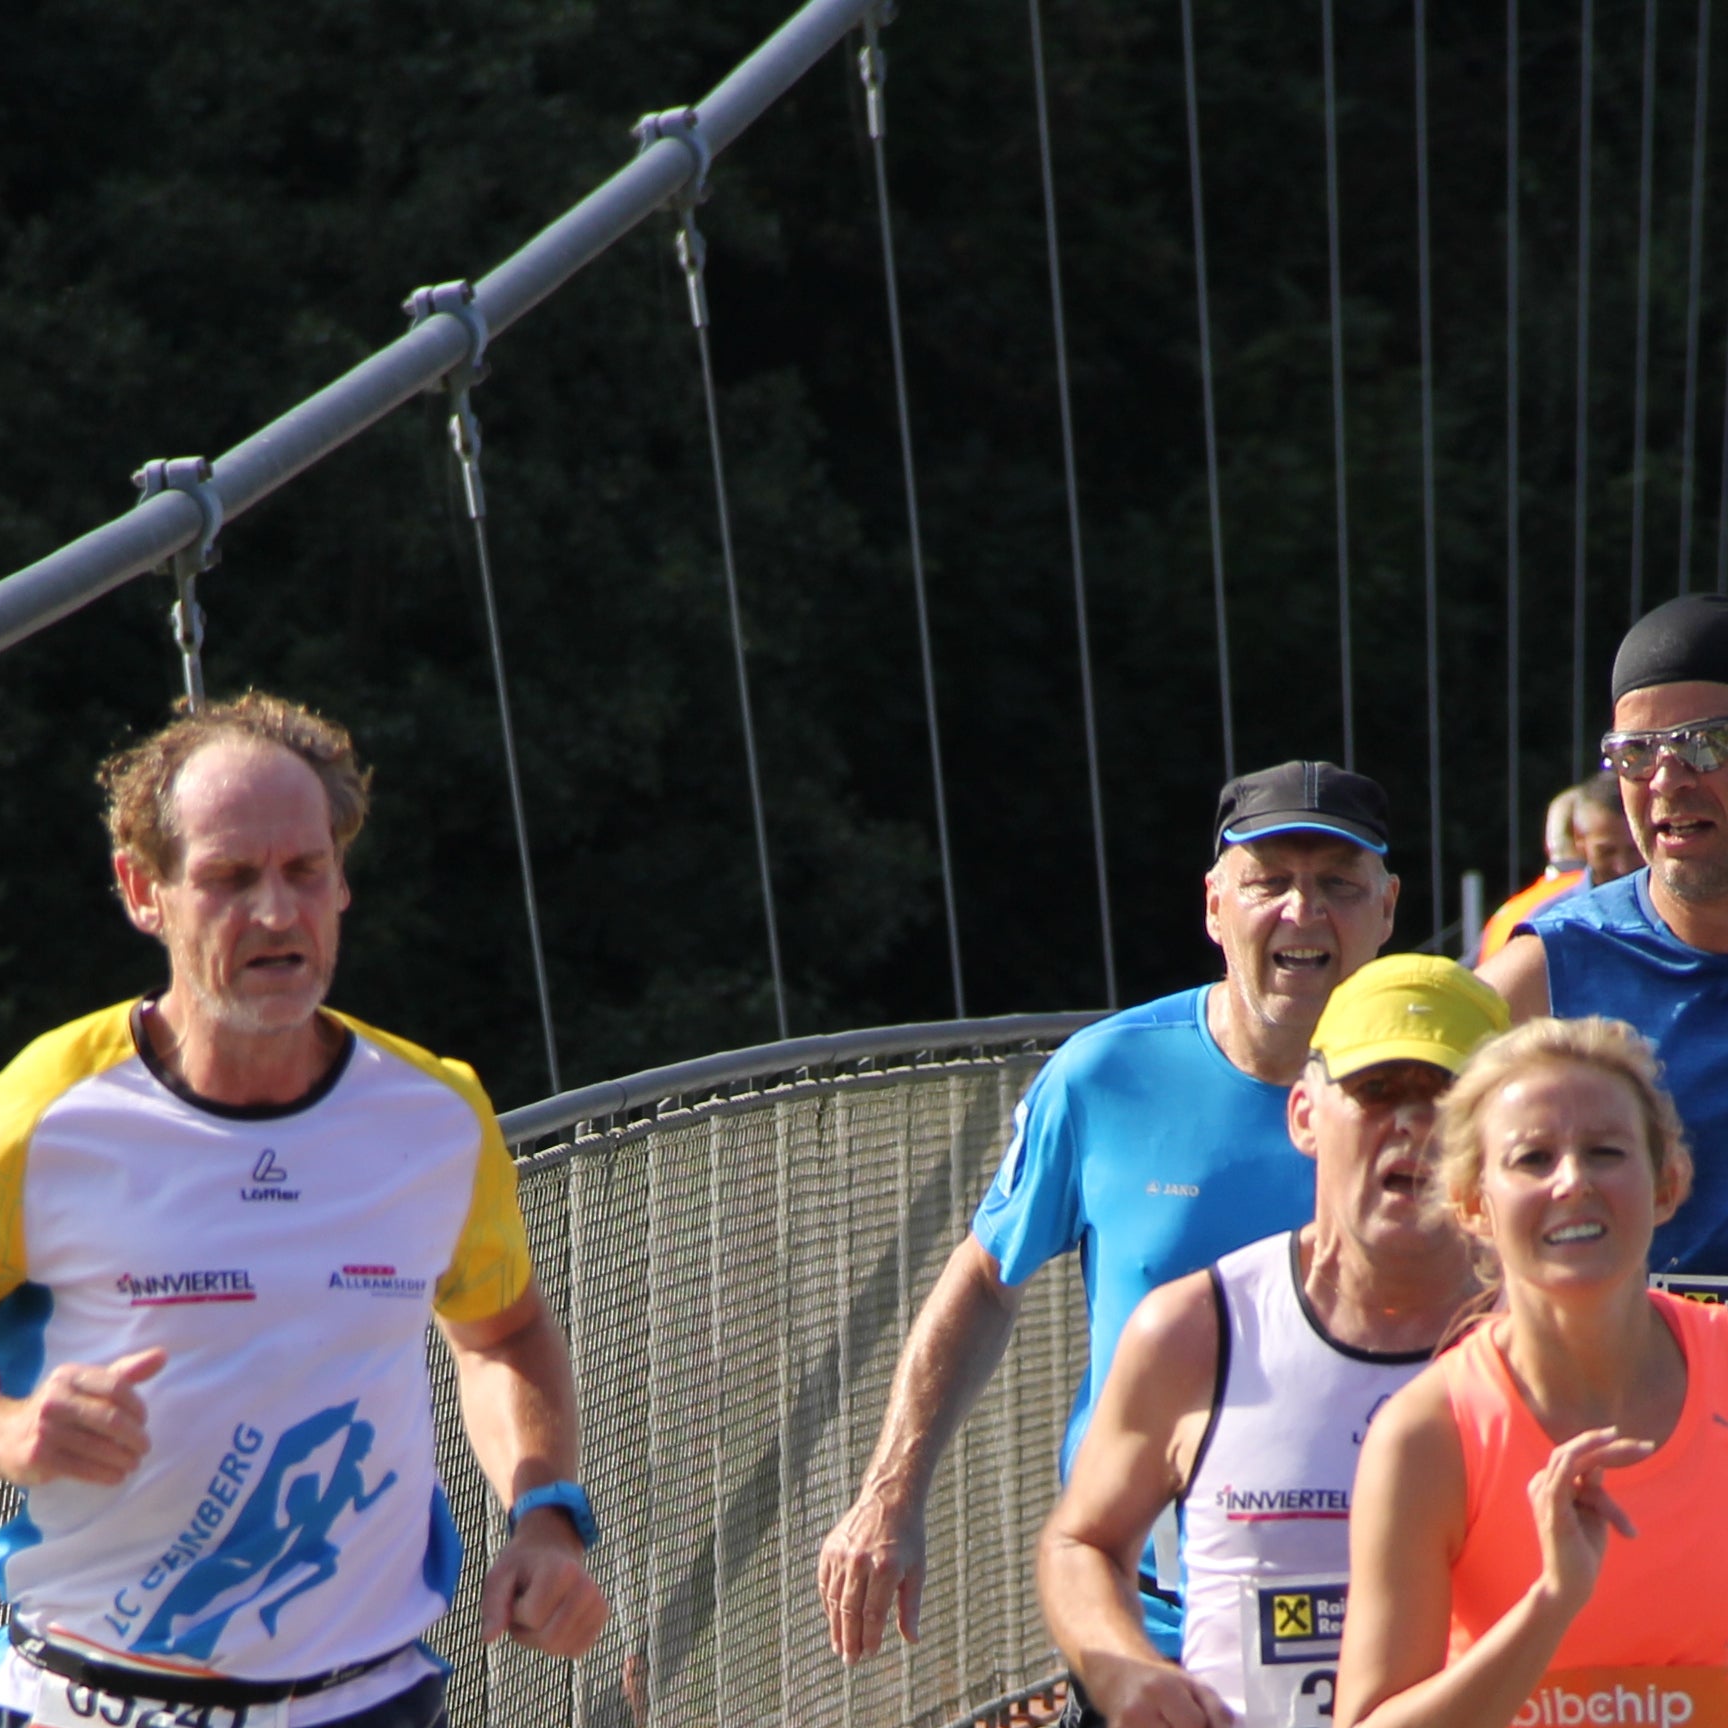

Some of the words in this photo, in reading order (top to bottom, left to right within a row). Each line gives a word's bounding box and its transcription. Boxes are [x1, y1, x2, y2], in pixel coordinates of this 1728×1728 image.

[1163, 1183, 1200, 1198] JAKO
[104, 1587, 142, 1638] LC
[140, 1421, 265, 1591] GEINBERG
